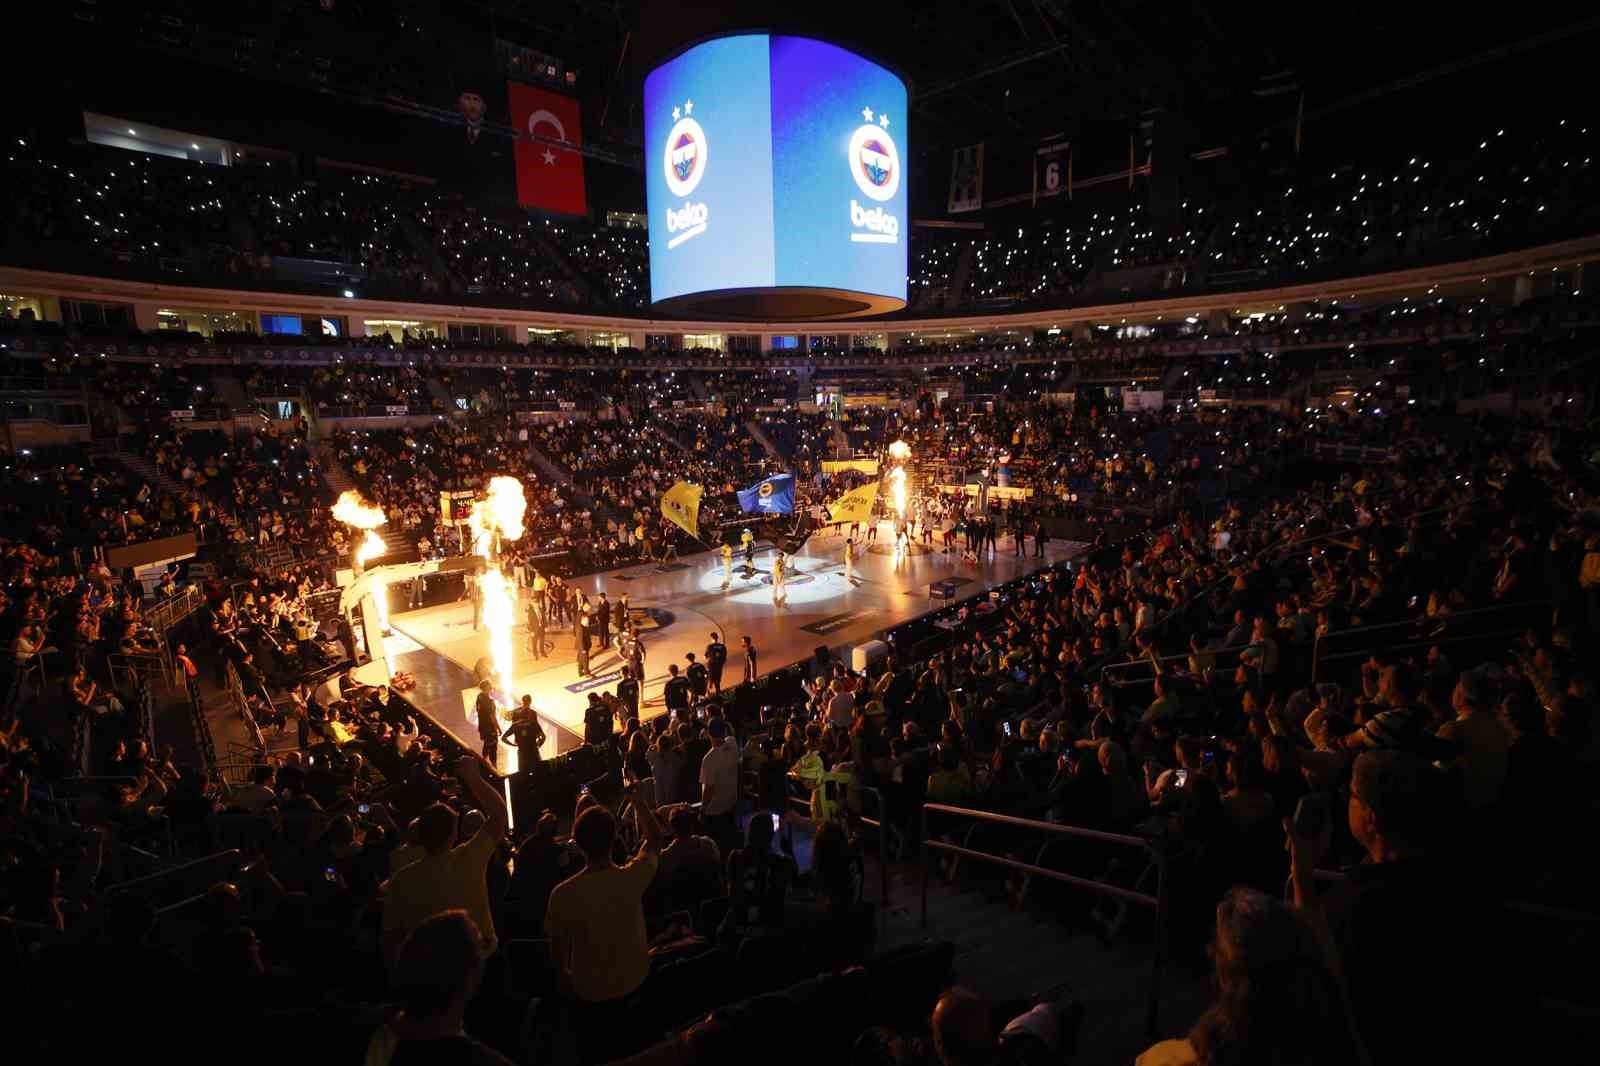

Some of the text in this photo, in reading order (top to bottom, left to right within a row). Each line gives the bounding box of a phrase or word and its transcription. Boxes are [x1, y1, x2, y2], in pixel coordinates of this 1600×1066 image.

[1046, 162, 1060, 191] 6
[666, 200, 708, 233] beko
[850, 199, 898, 236] beko
